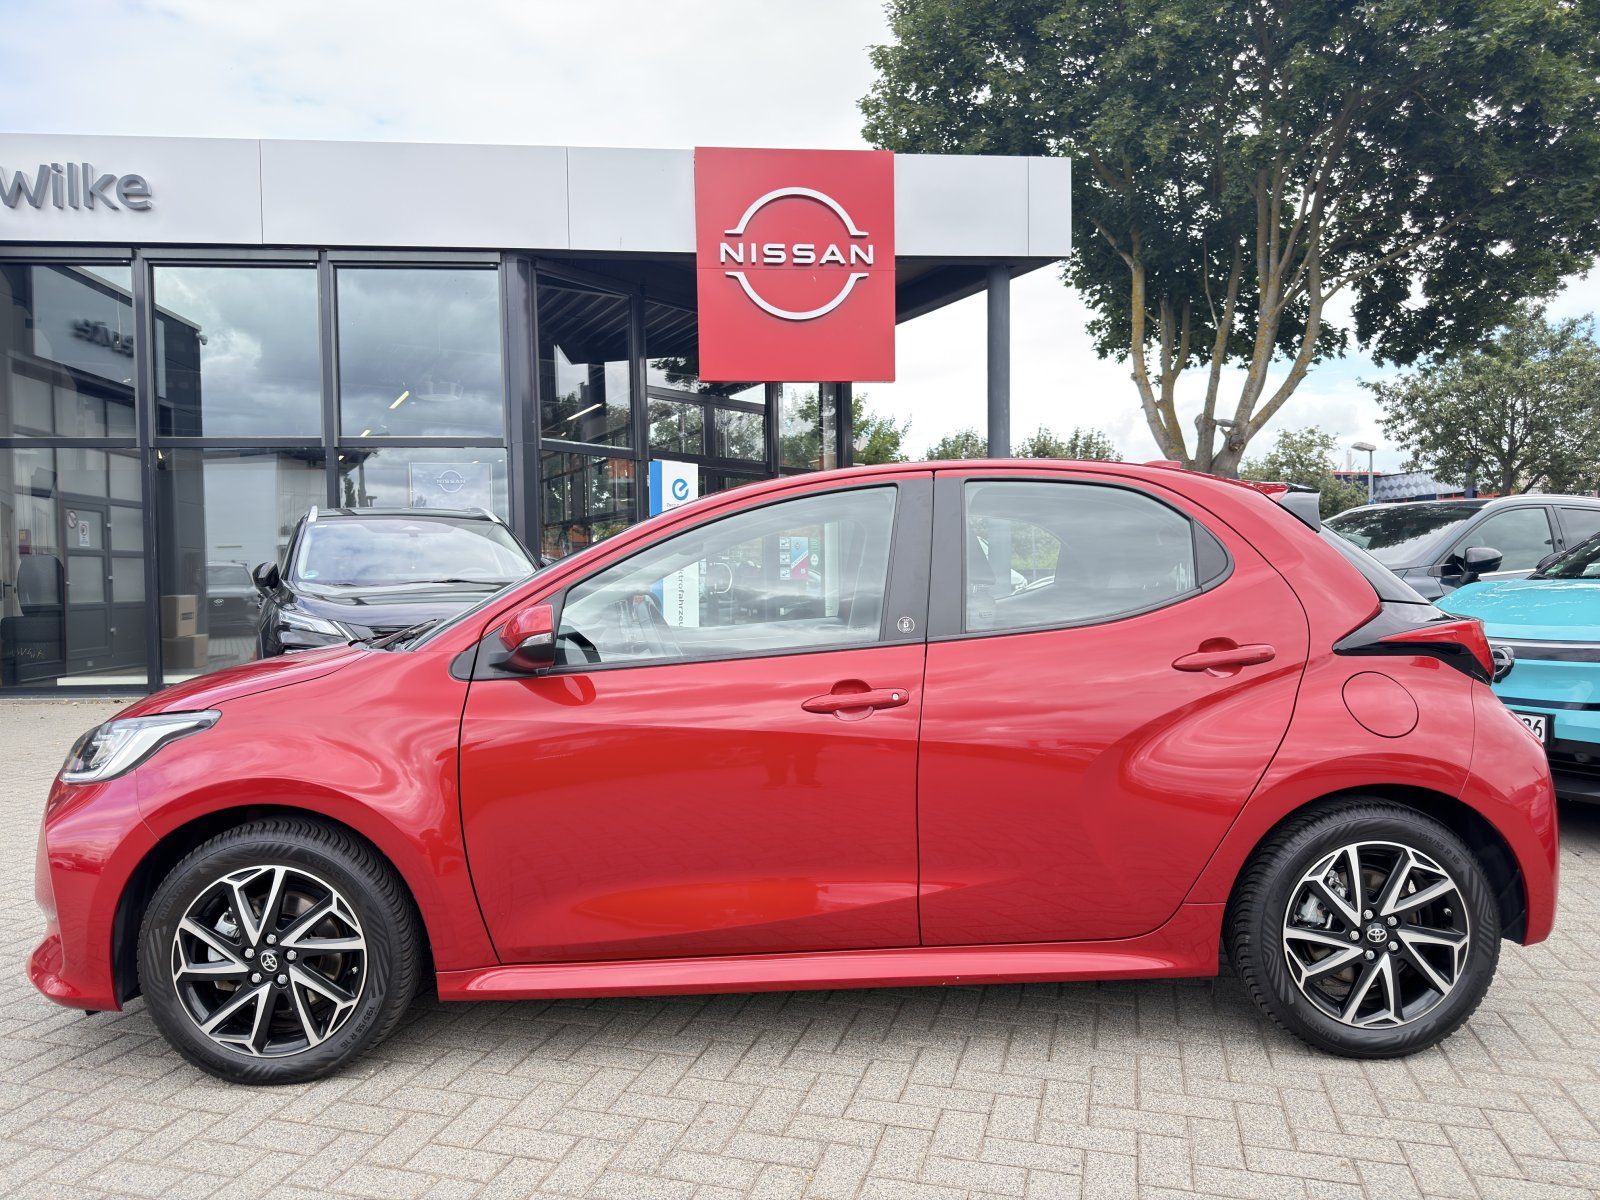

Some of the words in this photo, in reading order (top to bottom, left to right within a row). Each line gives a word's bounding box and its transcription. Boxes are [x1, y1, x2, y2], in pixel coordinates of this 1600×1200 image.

[719, 242, 874, 265] NISSAN
[355, 1006, 376, 1033] 195/55
[349, 1032, 358, 1041] R
